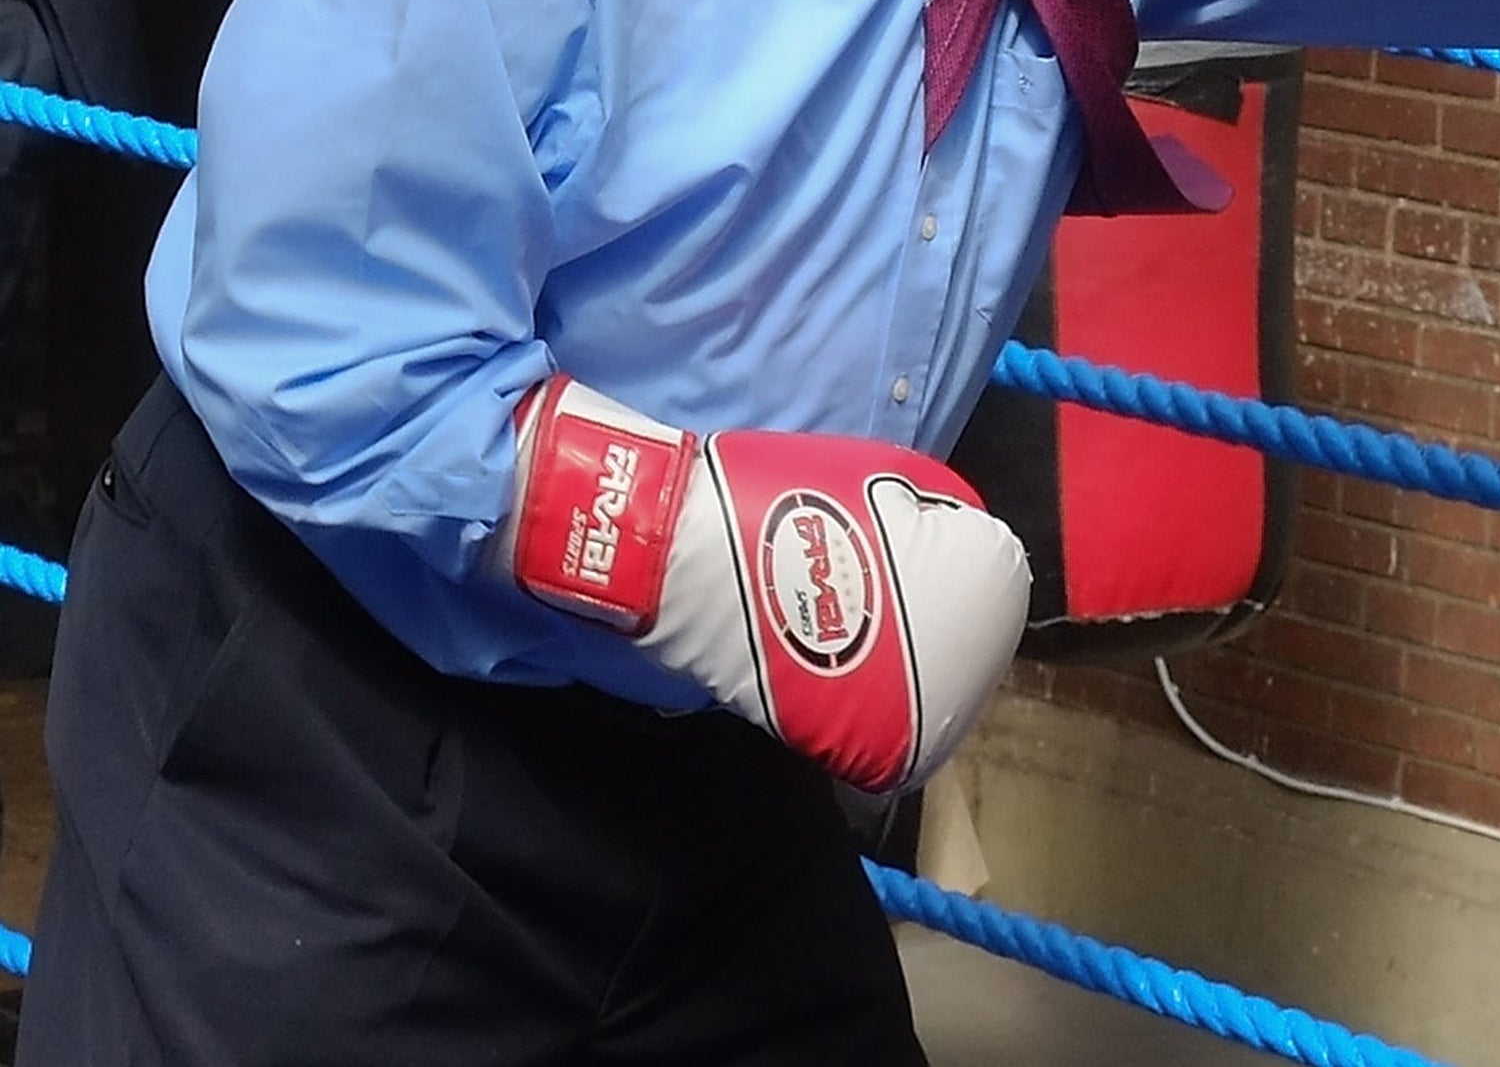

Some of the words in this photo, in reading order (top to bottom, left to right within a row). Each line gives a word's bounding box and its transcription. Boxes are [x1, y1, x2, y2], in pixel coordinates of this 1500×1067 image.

[562, 505, 588, 578] SPORTS
[578, 442, 638, 587] FARABI
[793, 514, 850, 643] FARABI
